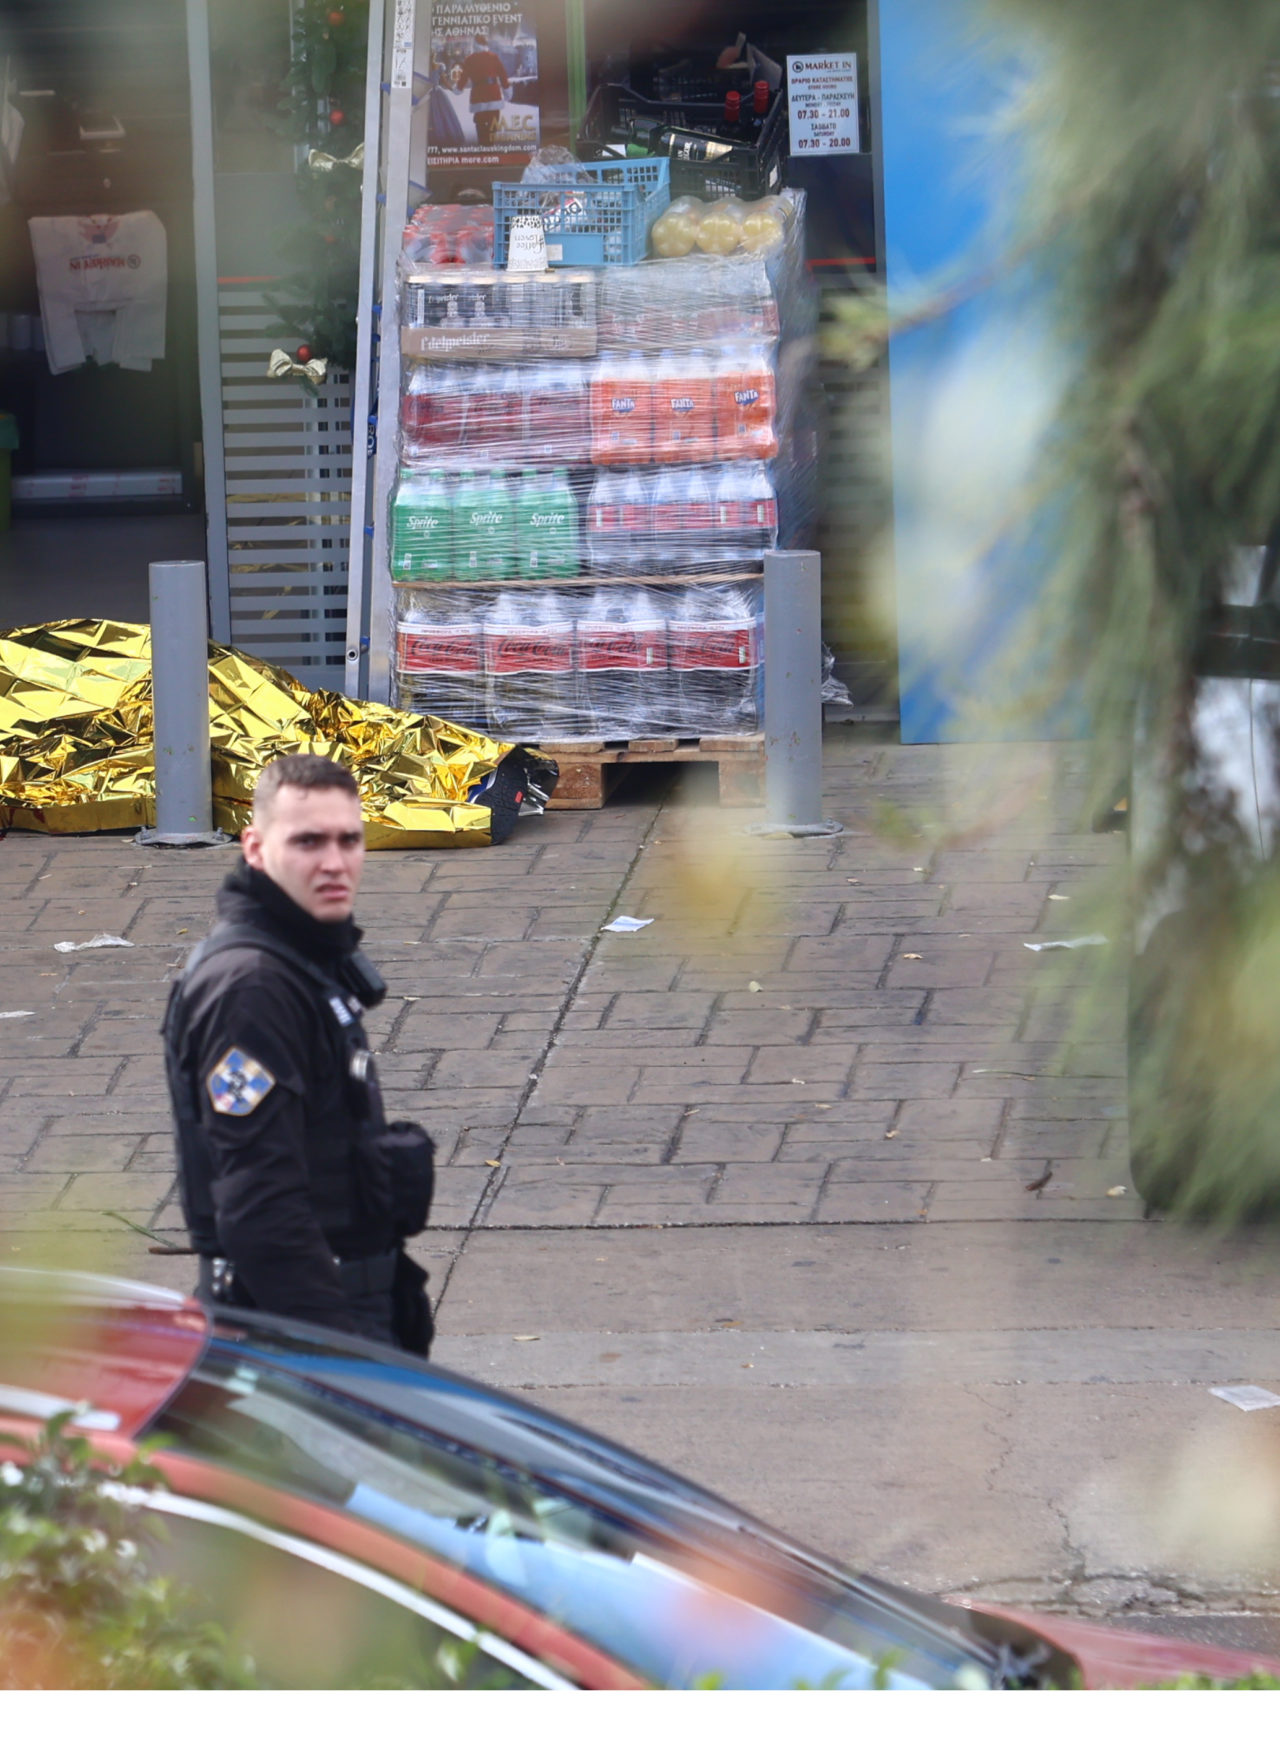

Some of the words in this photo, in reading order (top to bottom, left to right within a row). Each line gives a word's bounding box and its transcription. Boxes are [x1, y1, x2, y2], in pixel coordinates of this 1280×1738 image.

[436, 3, 511, 14] ΠΑΡΑΜΥΘΕΝΙΟ
[492, 13, 523, 24] EVENT
[445, 26, 489, 36] ΑΘΗΝΑΣ
[792, 94, 816, 102] ΔΕΥΤΕΡΑ
[797, 109, 819, 119] 07.30
[828, 108, 850, 118] 21.00
[798, 139, 820, 148] 07.30
[829, 138, 851, 147] 20.00
[461, 156, 500, 164] more.com
[407, 516, 439, 530] Sprite
[470, 512, 503, 525] Sprite
[530, 512, 565, 528] Sprite
